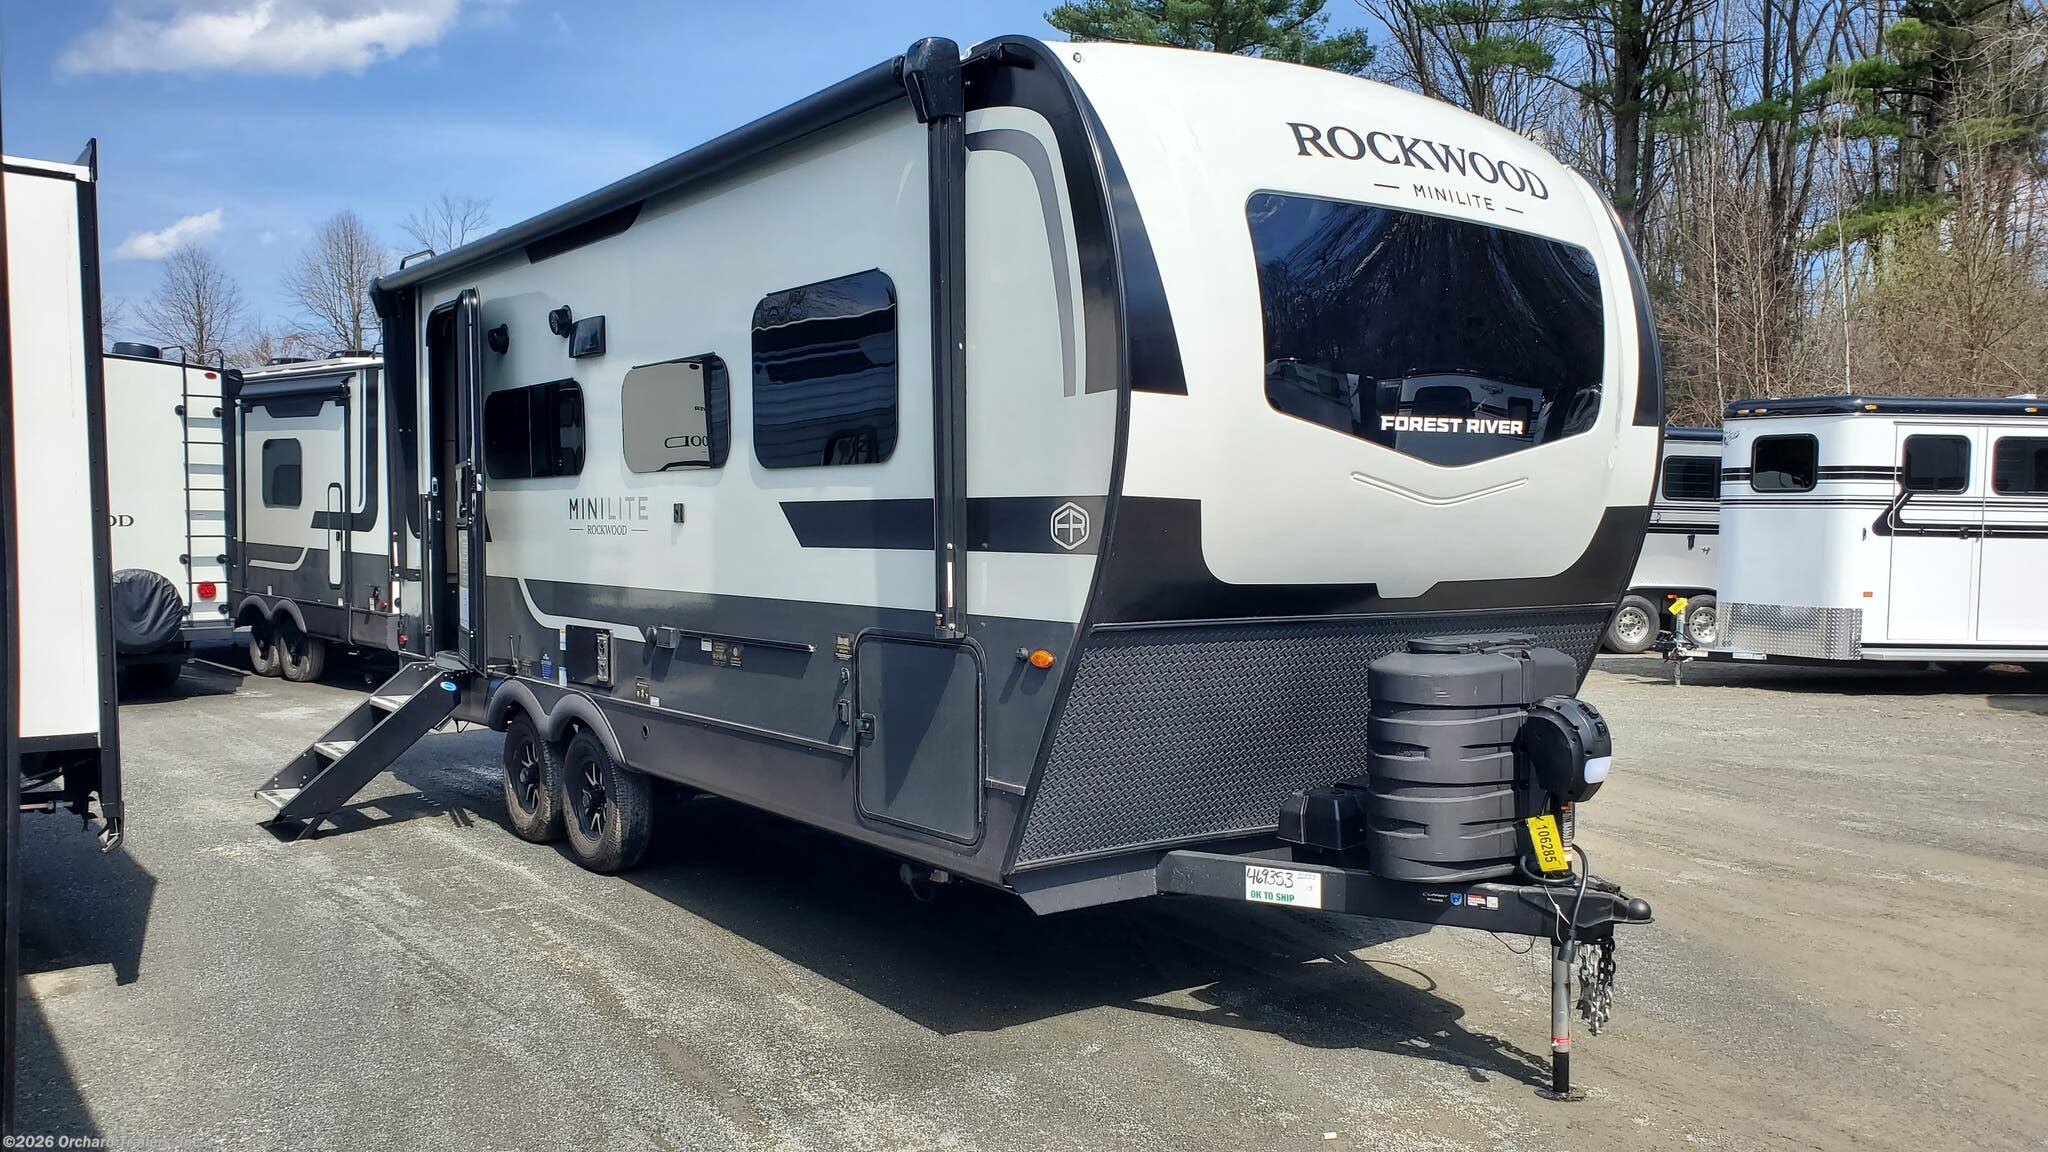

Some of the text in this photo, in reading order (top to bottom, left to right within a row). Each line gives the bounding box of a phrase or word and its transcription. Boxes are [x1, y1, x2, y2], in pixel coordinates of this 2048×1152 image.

[1286, 122, 1549, 200] ROCKWOOD
[1413, 183, 1495, 212] MINILITE
[1380, 415, 1524, 435] FOREST RIVER
[569, 496, 649, 521] MINILITE
[587, 524, 628, 536] ROCKWOOD
[1536, 824, 1557, 863] 106285
[1246, 867, 1294, 889] 469353
[1250, 889, 1295, 903] OK TO SHIP
